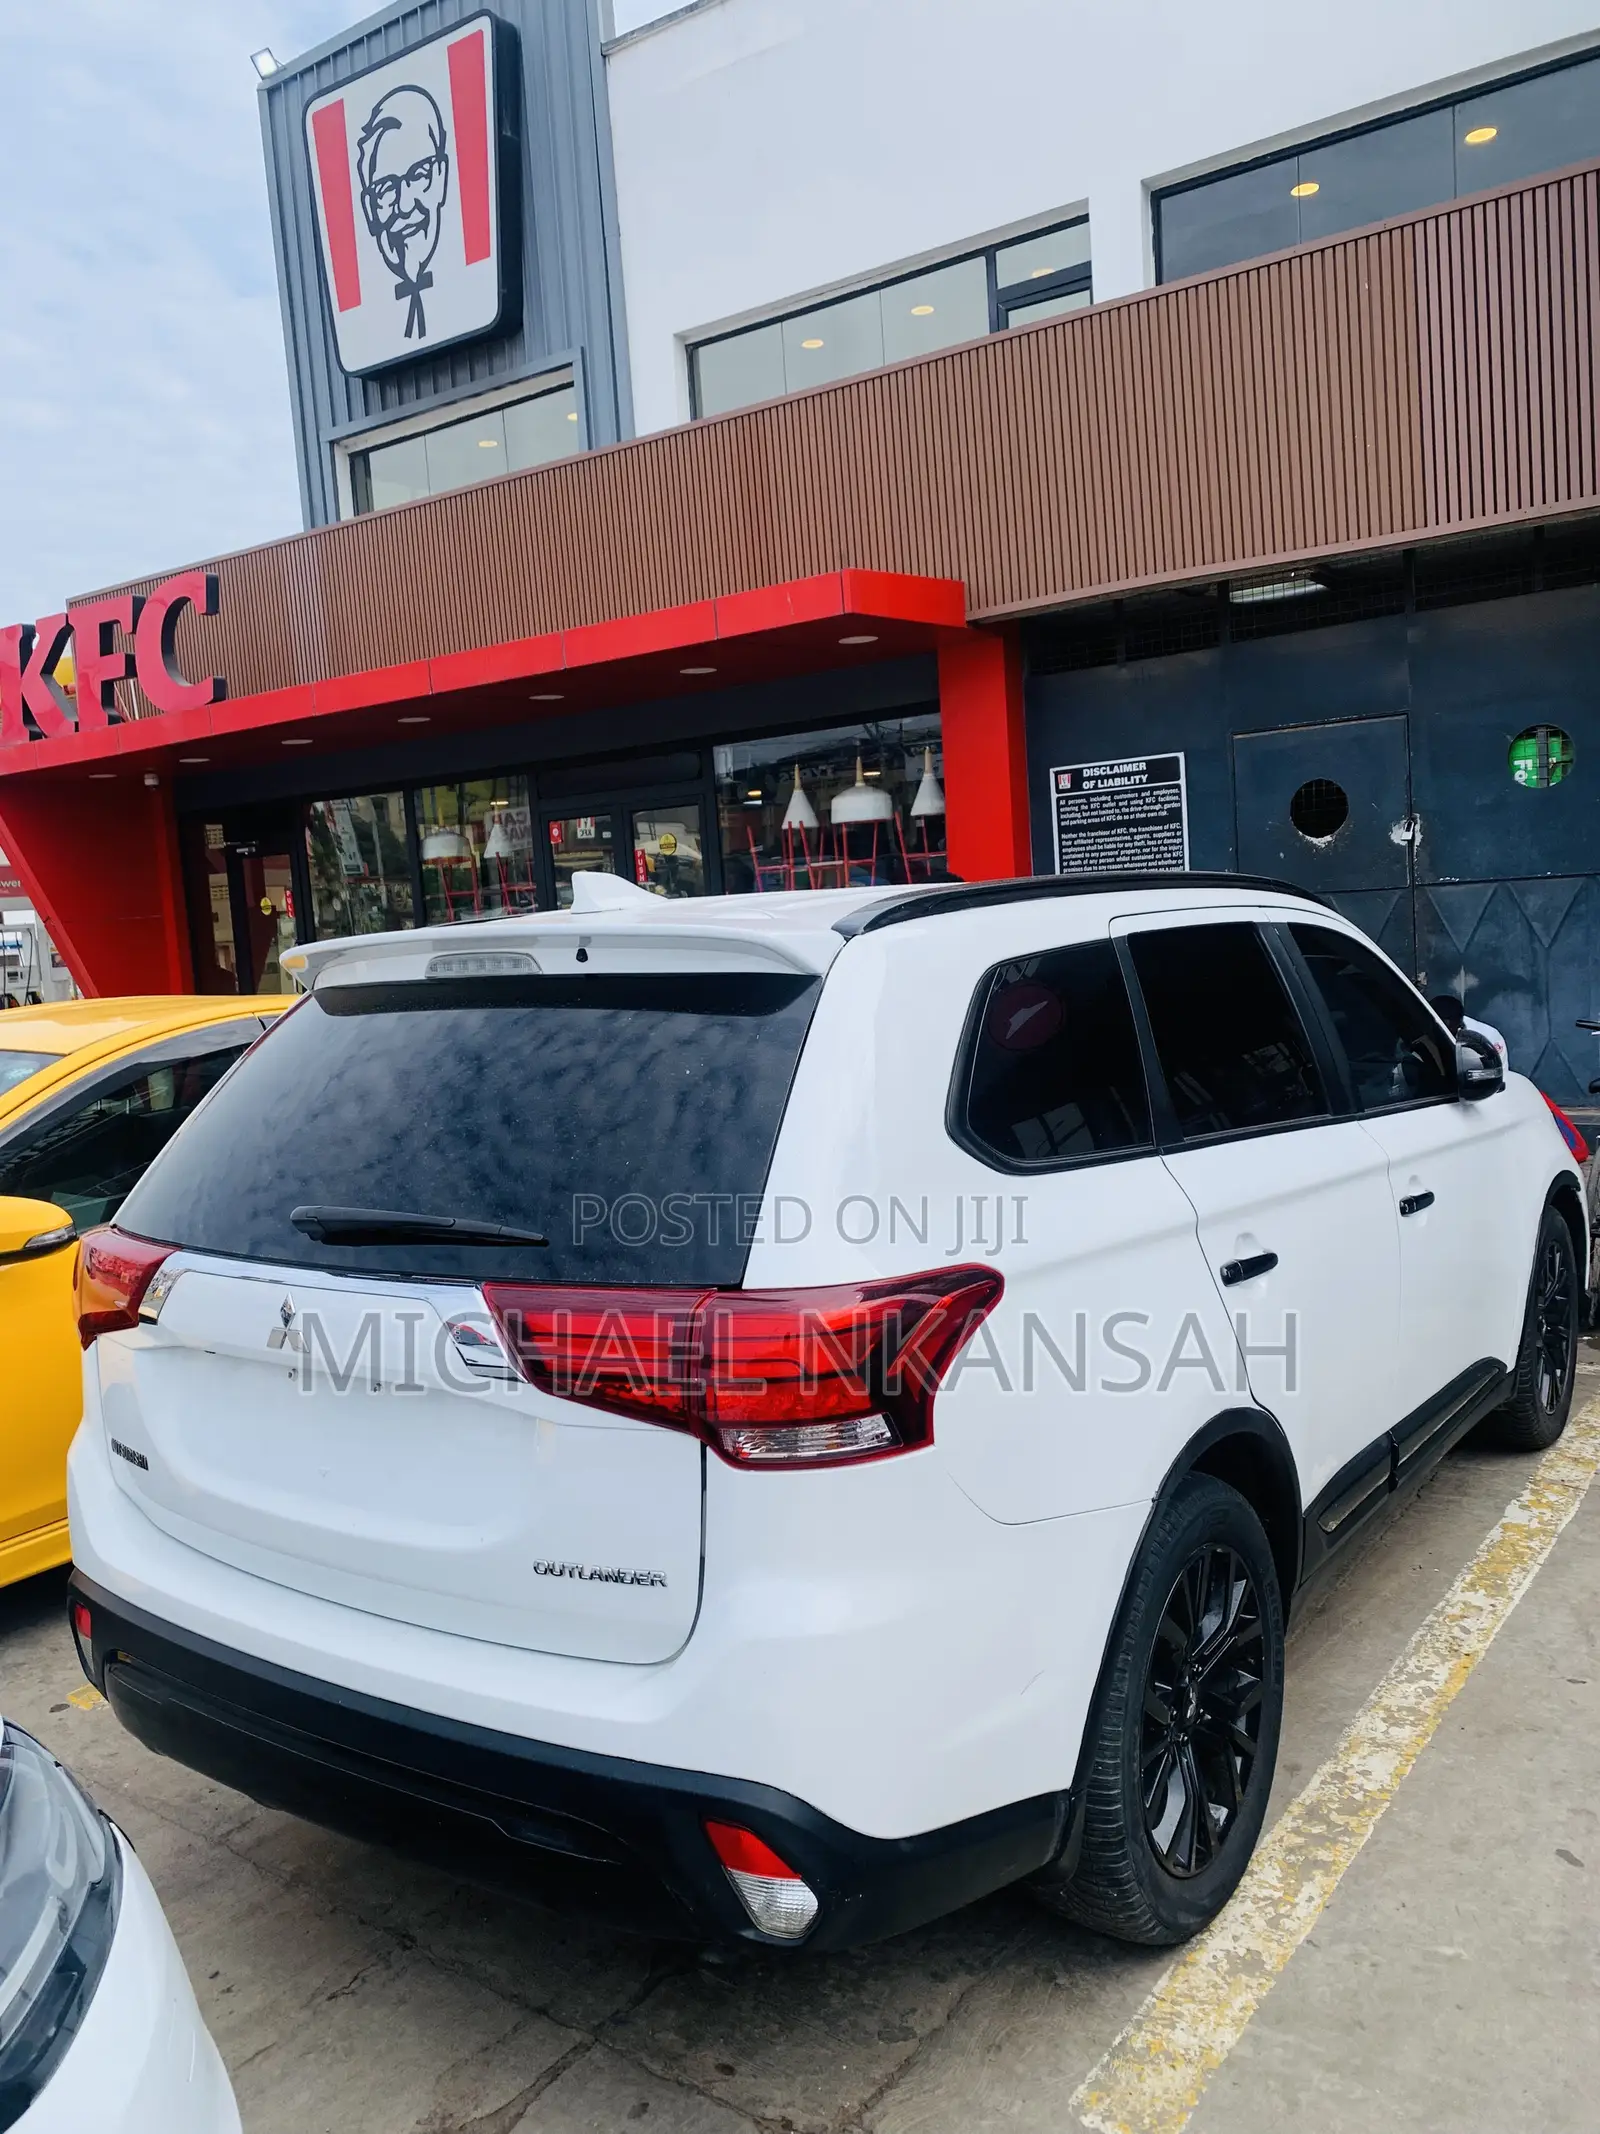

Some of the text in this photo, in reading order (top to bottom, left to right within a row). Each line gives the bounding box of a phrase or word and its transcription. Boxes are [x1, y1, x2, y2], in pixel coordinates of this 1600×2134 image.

[0, 571, 227, 746] KFC
[1083, 762, 1147, 777] DISCLAIMER
[1083, 774, 1148, 789] OF LIABILITY
[636, 850, 645, 881] PUSH
[533, 1558, 667, 1588] OUTLANDER
